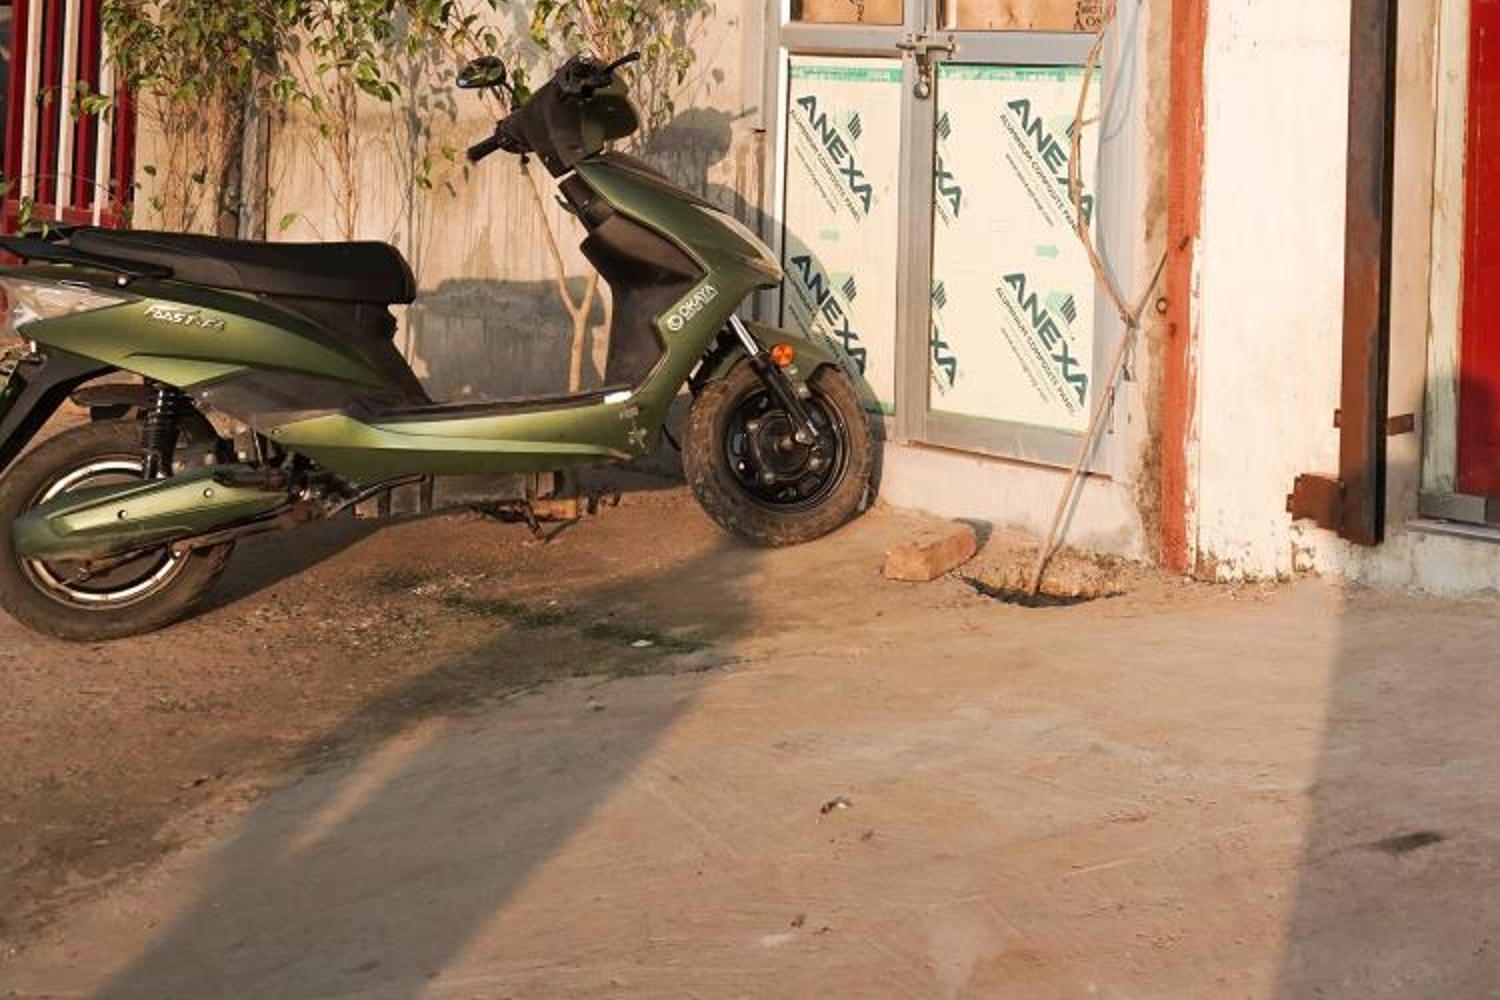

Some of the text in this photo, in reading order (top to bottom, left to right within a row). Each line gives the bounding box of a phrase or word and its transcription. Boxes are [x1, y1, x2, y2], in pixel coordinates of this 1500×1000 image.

[796, 94, 874, 216] ANEXA
[790, 254, 867, 377] ANEXA
[1002, 272, 1089, 407] ANEXA
